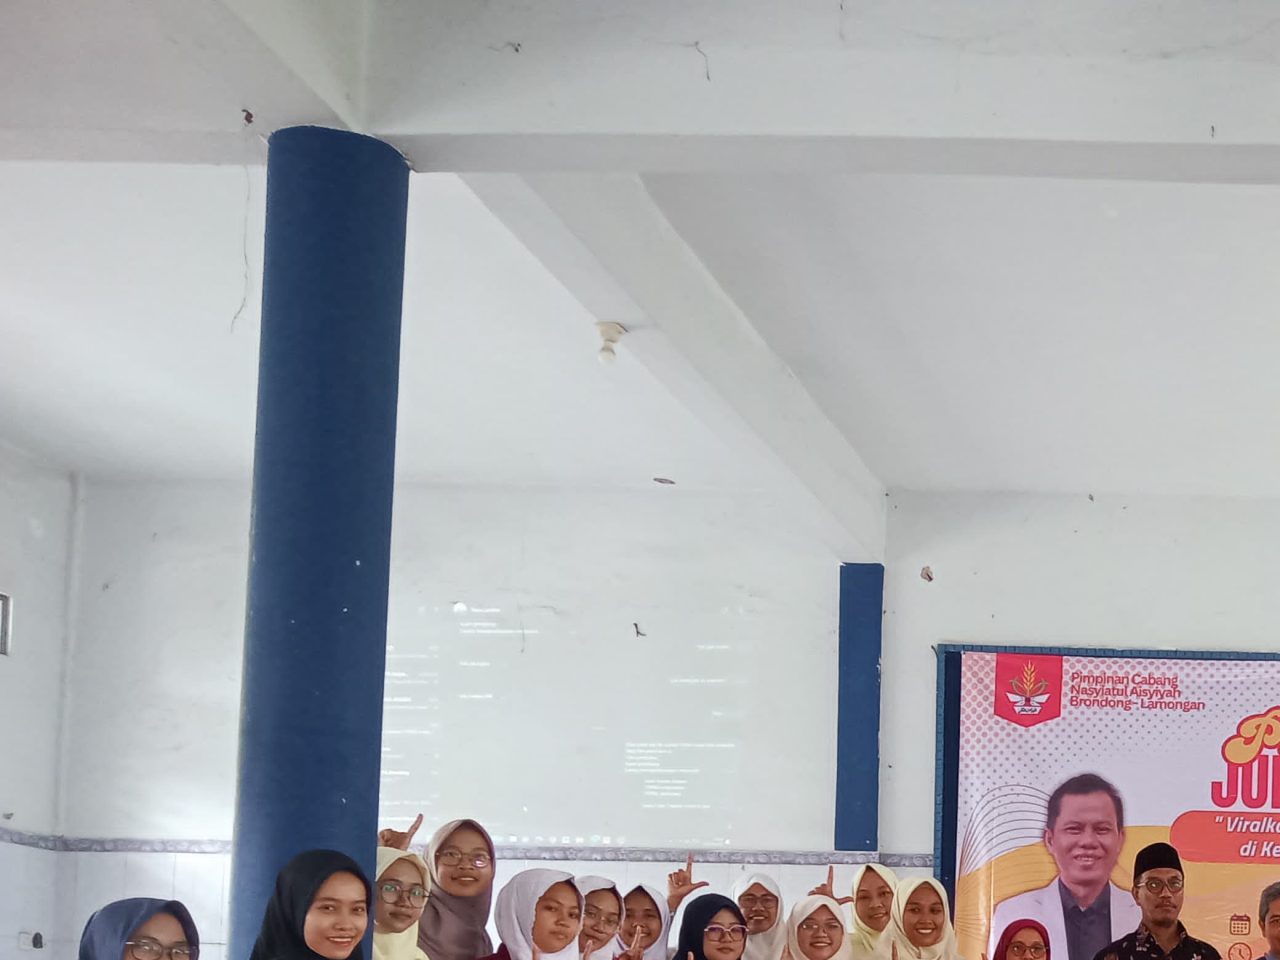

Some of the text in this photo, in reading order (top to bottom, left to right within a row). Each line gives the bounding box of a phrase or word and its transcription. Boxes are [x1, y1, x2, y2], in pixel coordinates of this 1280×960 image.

[1071, 672, 1178, 688] Pimpinan Cabang
[1070, 684, 1181, 700] Nasyiatul Aisyiyah
[1140, 699, 1206, 712] Lamongan
[1240, 841, 1257, 857] di
